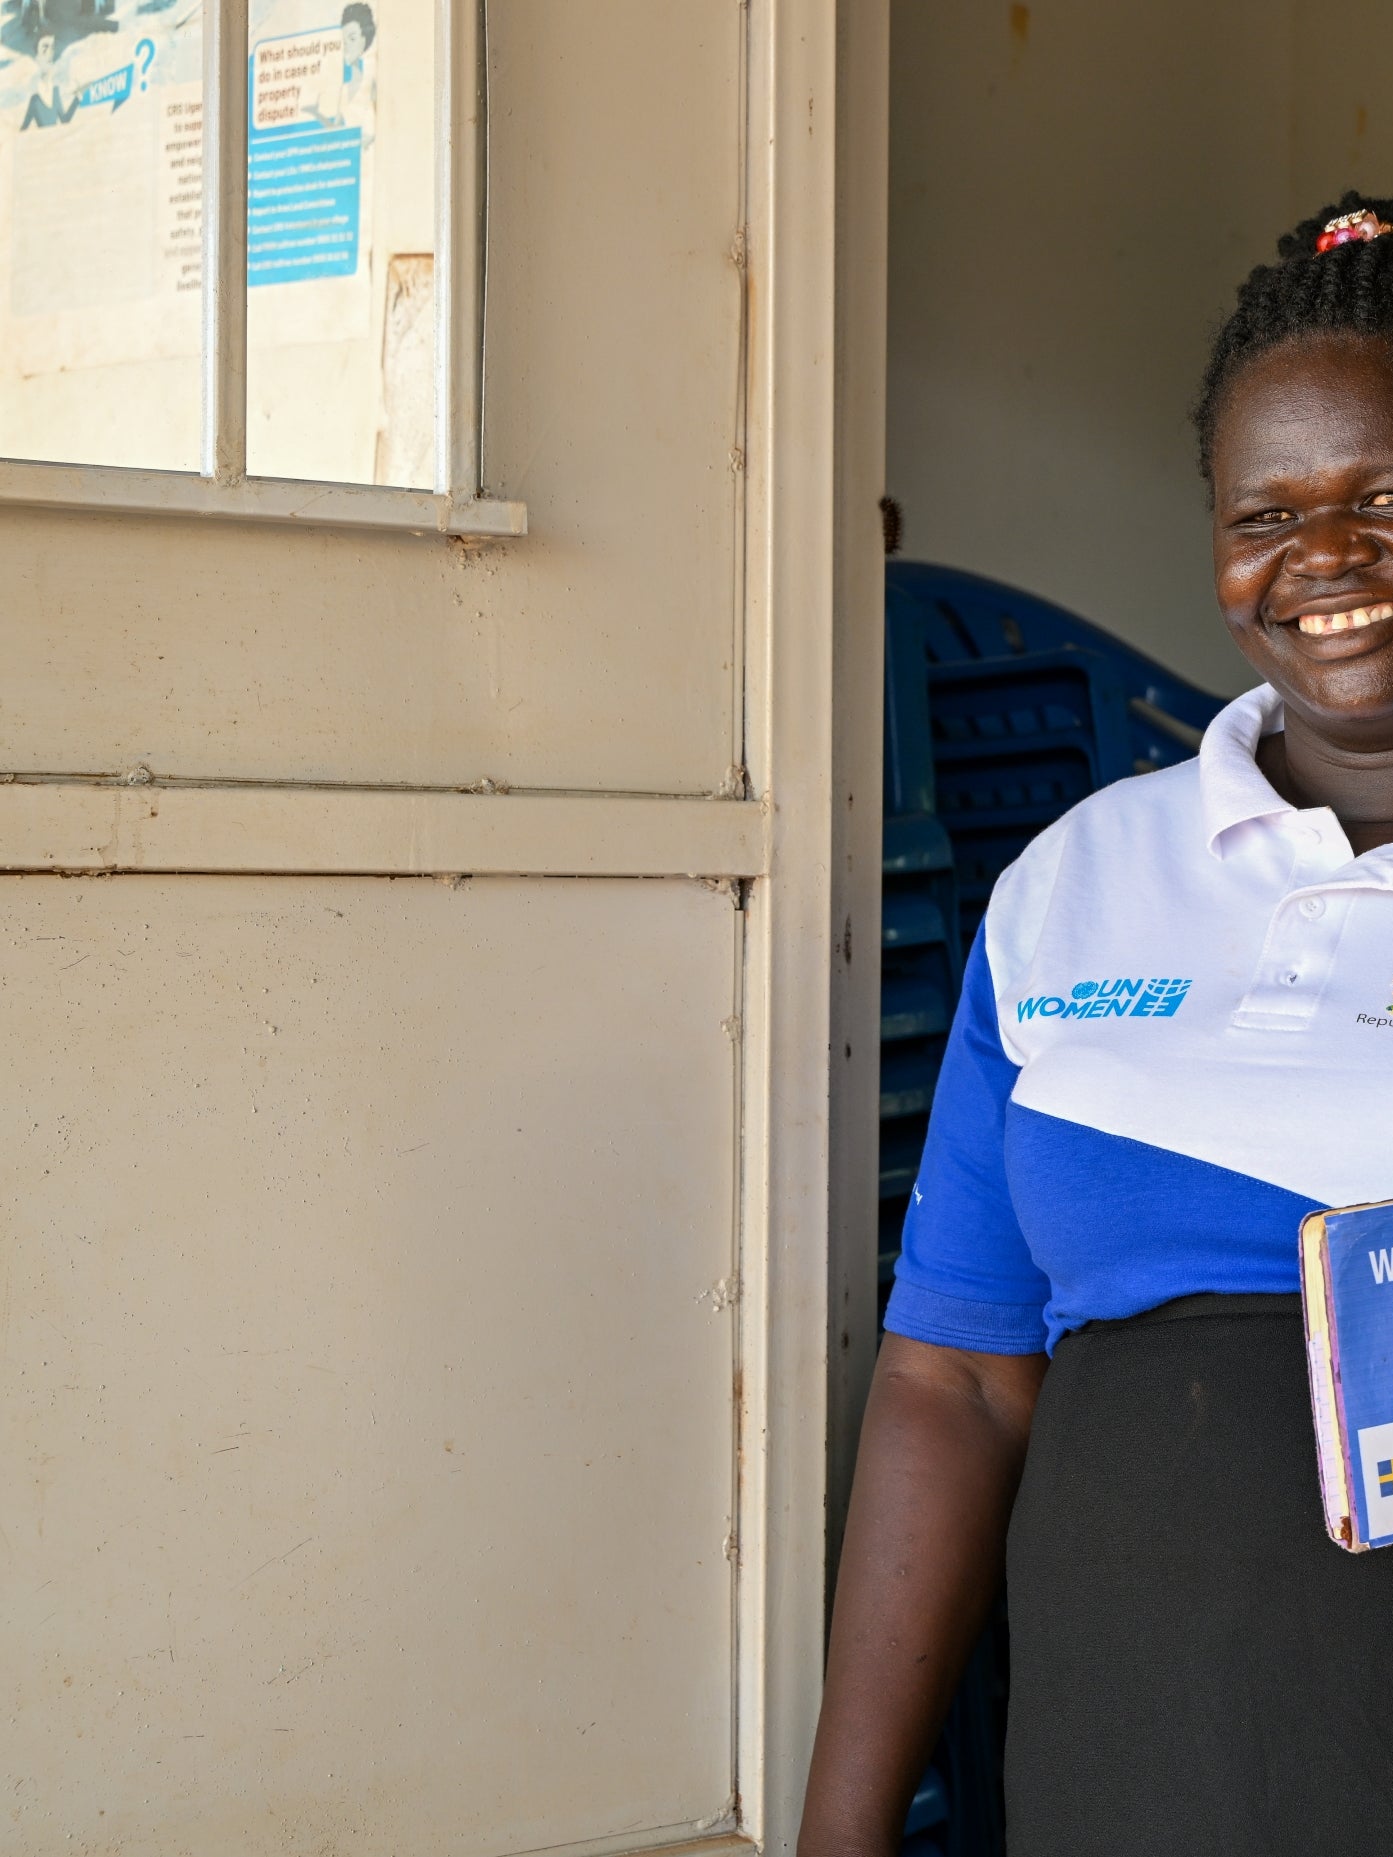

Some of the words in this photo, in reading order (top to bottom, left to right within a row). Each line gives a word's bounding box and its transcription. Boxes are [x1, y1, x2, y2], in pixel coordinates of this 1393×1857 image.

[260, 48, 284, 65] What
[287, 42, 320, 60] should
[322, 40, 342, 57] you
[258, 70, 270, 84] do
[273, 68, 283, 81] in
[285, 66, 307, 79] case
[310, 60, 321, 75] of
[91, 70, 127, 104] KNOW
[258, 85, 301, 107] property
[1097, 978, 1144, 998] UN
[1017, 996, 1132, 1023] WOMEN
